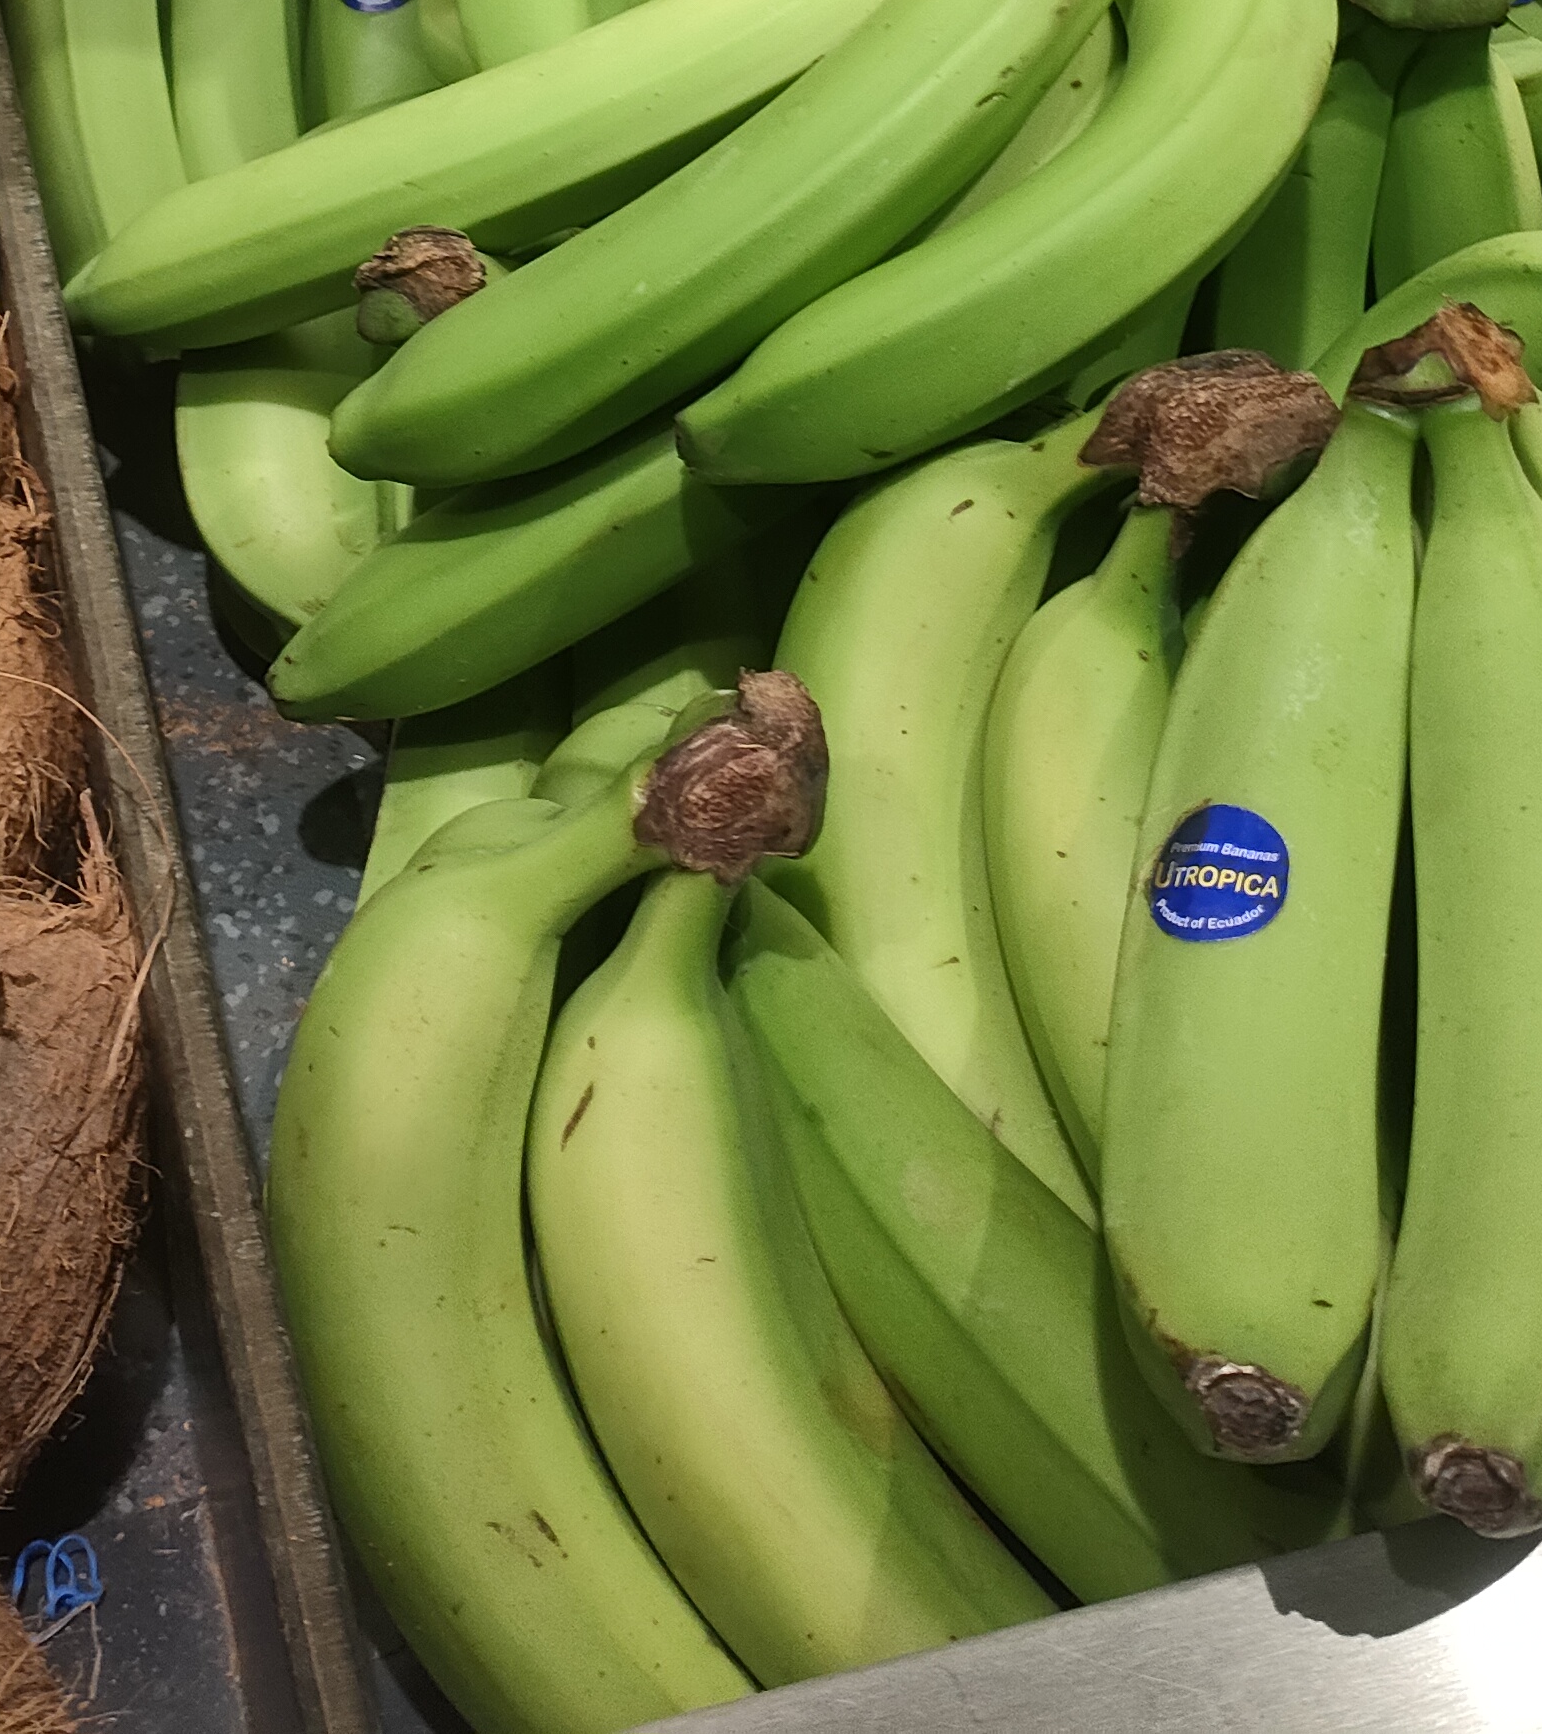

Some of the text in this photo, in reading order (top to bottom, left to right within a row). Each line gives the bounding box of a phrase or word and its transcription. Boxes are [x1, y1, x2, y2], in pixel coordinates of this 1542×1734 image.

[1221, 843, 1279, 862] Bananas
[1155, 861, 1278, 898] UTROPICA
[1156, 898, 1265, 930] Product Ecuador
